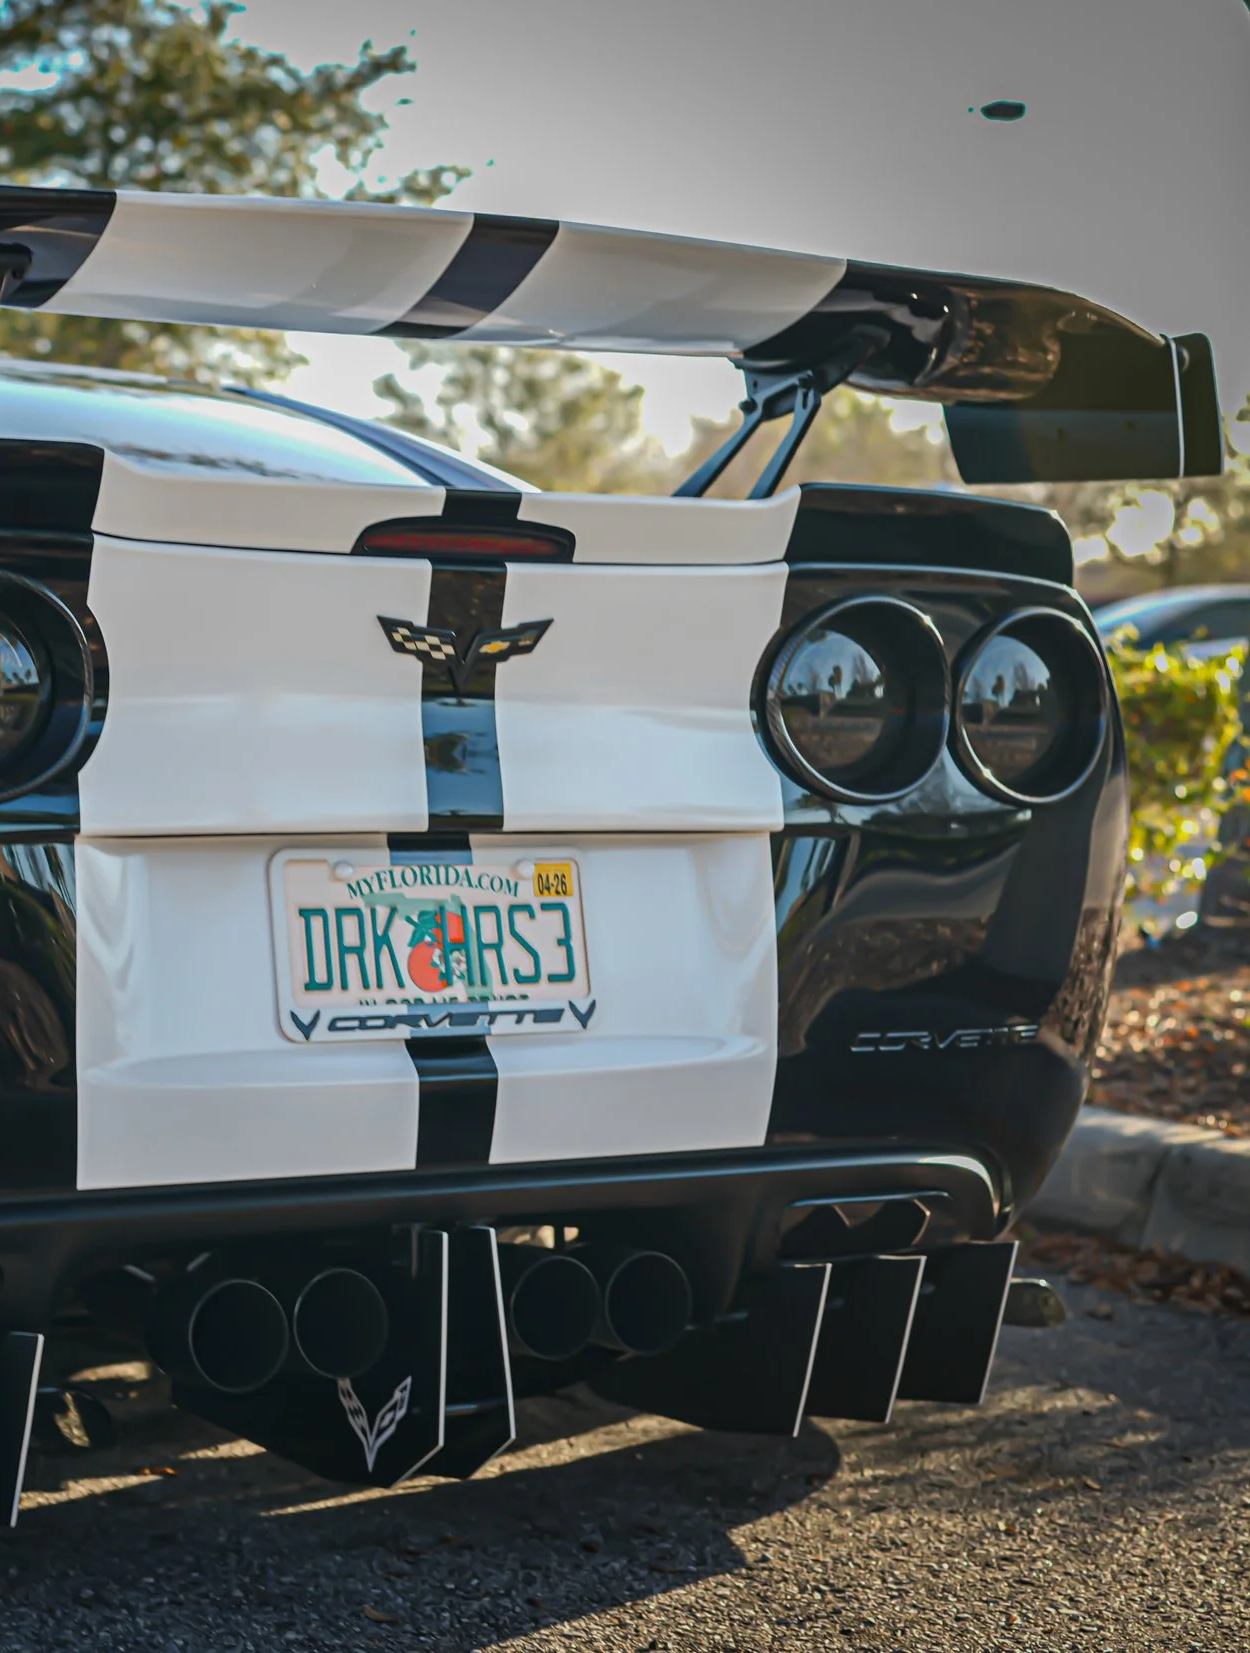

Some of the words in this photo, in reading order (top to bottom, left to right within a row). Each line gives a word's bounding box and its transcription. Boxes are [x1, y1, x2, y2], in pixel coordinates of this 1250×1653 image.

[346, 864, 519, 899] MYFLORIDA.COM
[298, 905, 406, 991] DRK
[327, 1008, 565, 1032] CORVETTE
